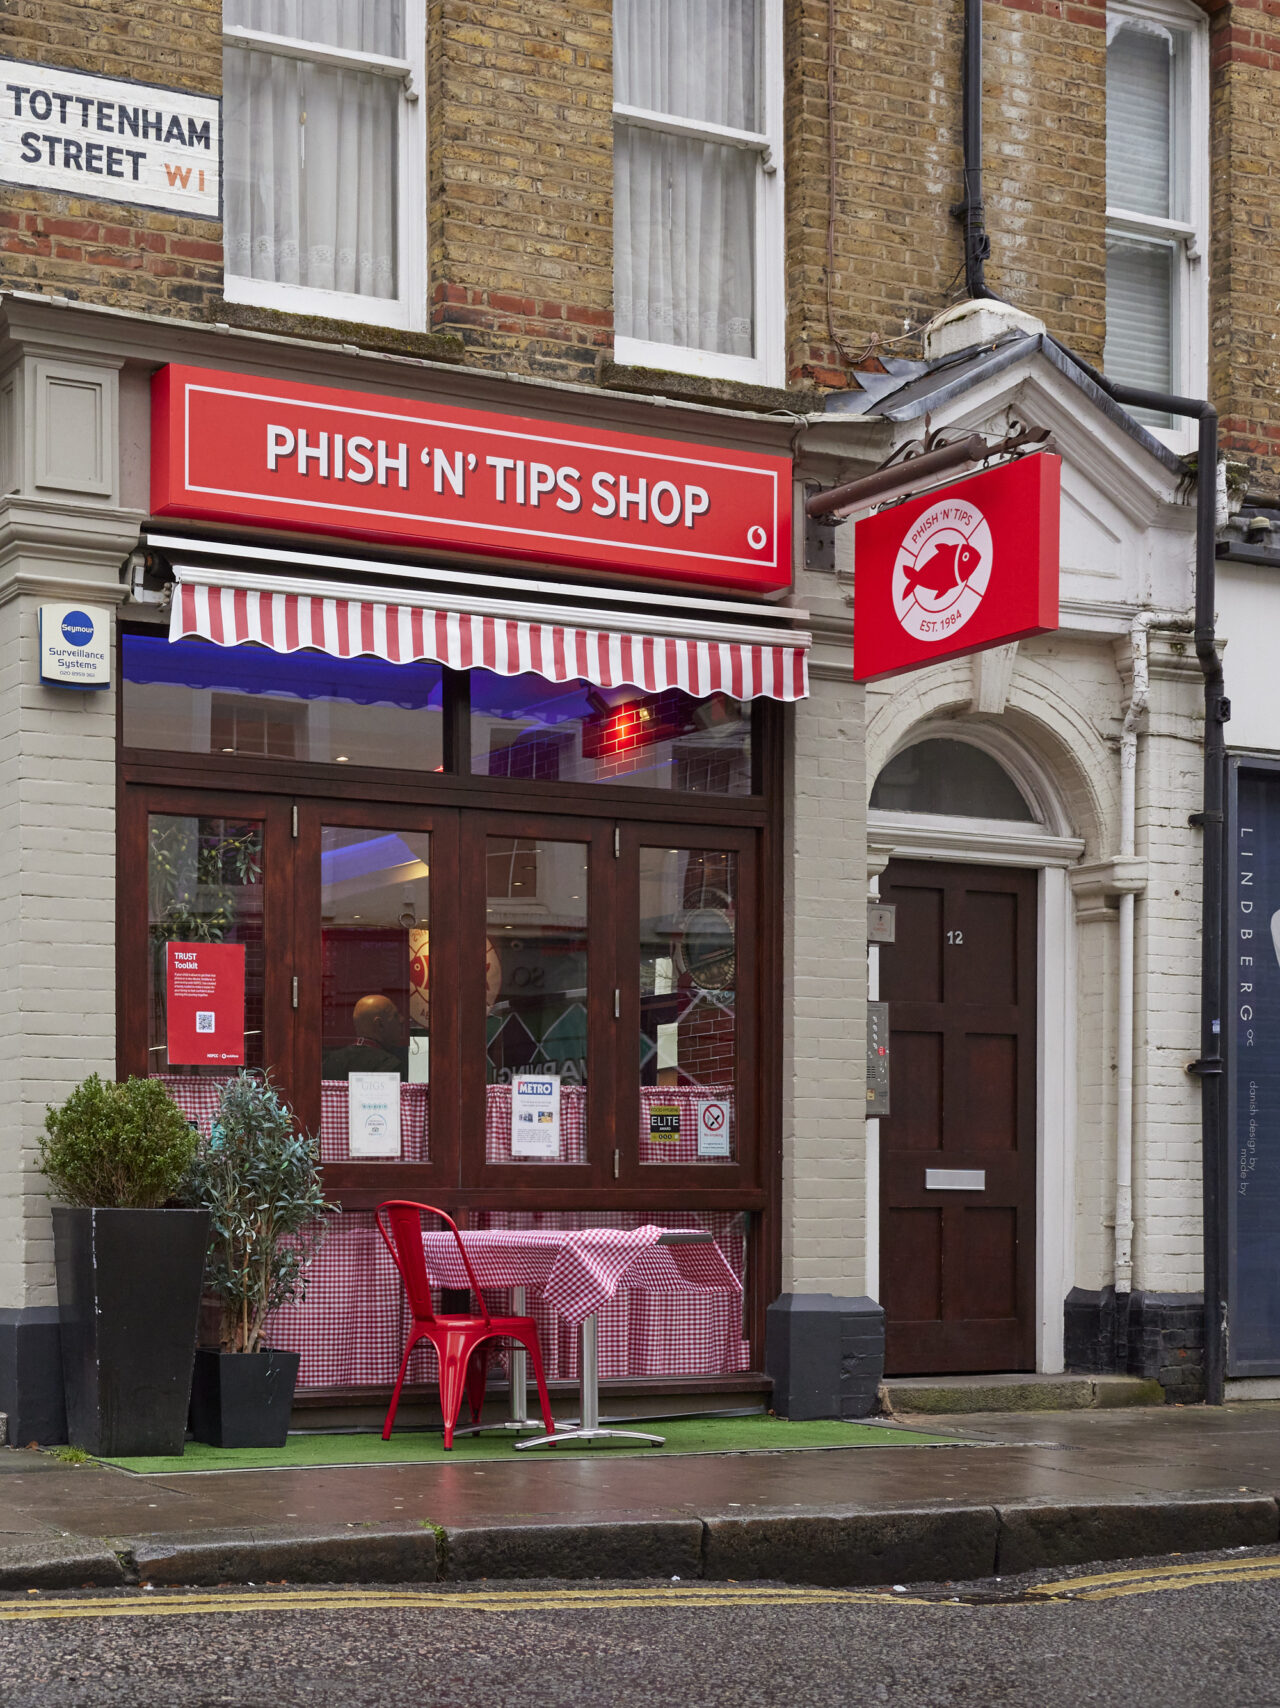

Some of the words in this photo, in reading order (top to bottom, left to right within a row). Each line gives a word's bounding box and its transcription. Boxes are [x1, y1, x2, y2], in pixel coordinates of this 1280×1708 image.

[6, 84, 211, 150] TOTTENHAM
[20, 131, 147, 181] STREET
[265, 423, 409, 490] PHISH
[485, 456, 582, 514] TIPS
[591, 471, 711, 529] SHOP
[911, 512, 939, 544] PHISH
[953, 508, 973, 526] TIPS
[61, 623, 94, 634] Seymour
[920, 619, 938, 633] EST.
[939, 609, 962, 631] 1984
[48, 647, 105, 660] Surveillance
[57, 658, 97, 670] Systems
[1240, 827, 1253, 1022] LINDBERG
[946, 930, 964, 945] 12
[174, 952, 197, 961] TRUST
[174, 961, 198, 970] Toolkit
[519, 1082, 552, 1094] METRO
[1249, 1080, 1260, 1116] danish
[651, 1116, 679, 1126] ELITE
[1247, 1118, 1259, 1154] design
[1240, 1148, 1250, 1179] made
[1248, 1157, 1259, 1172] by
[1238, 1182, 1250, 1196] by
